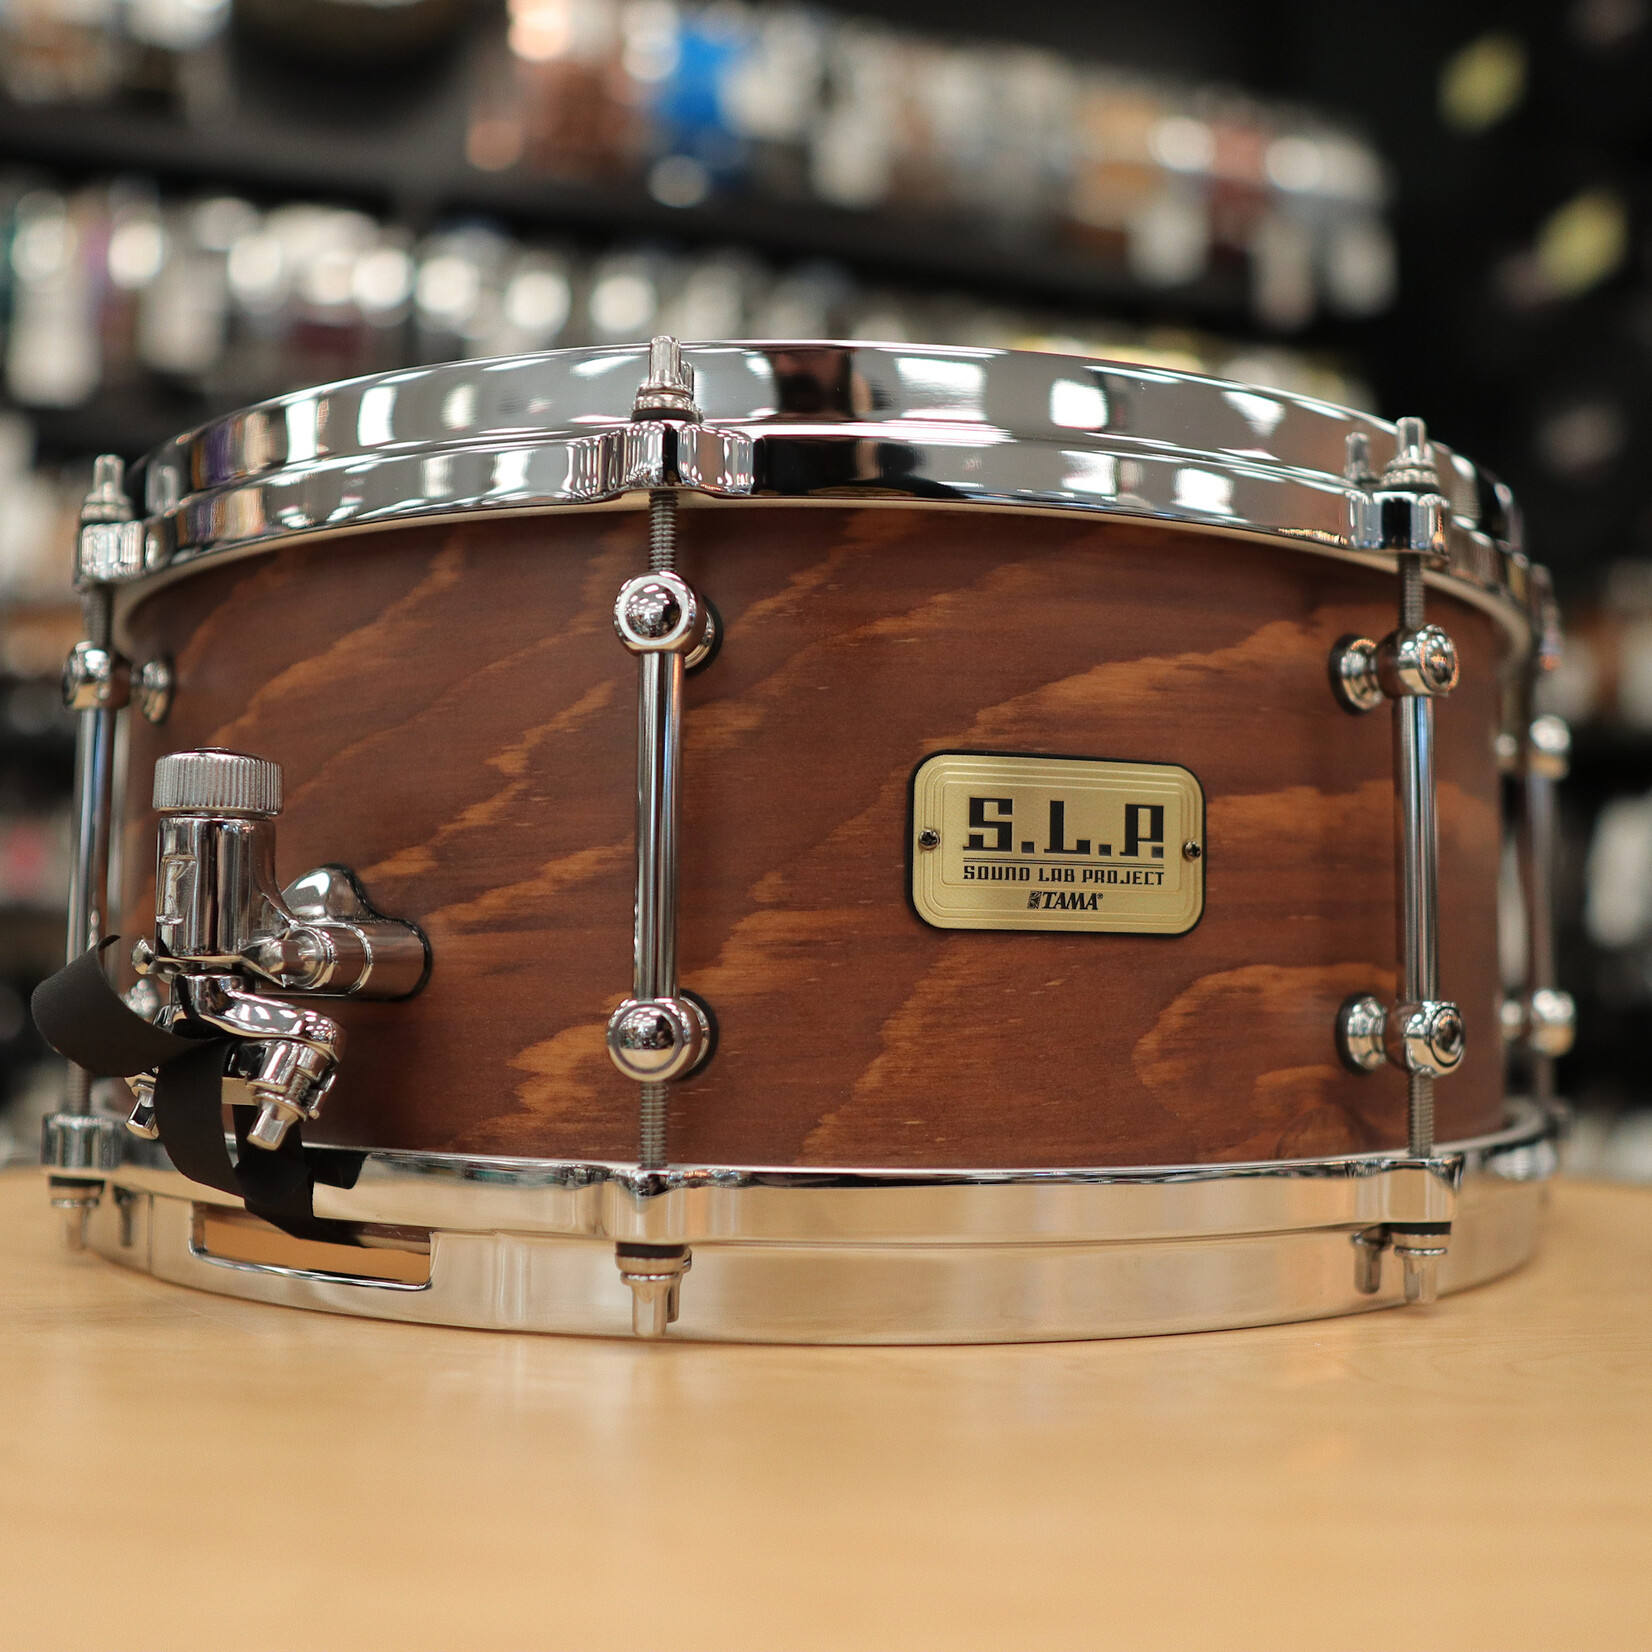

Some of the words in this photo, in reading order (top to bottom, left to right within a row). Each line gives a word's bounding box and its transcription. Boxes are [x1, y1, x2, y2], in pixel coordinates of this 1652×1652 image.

[963, 865, 1030, 882] SOUND
[1038, 867, 1075, 883] LAB
[1081, 869, 1164, 886] PROJECT
